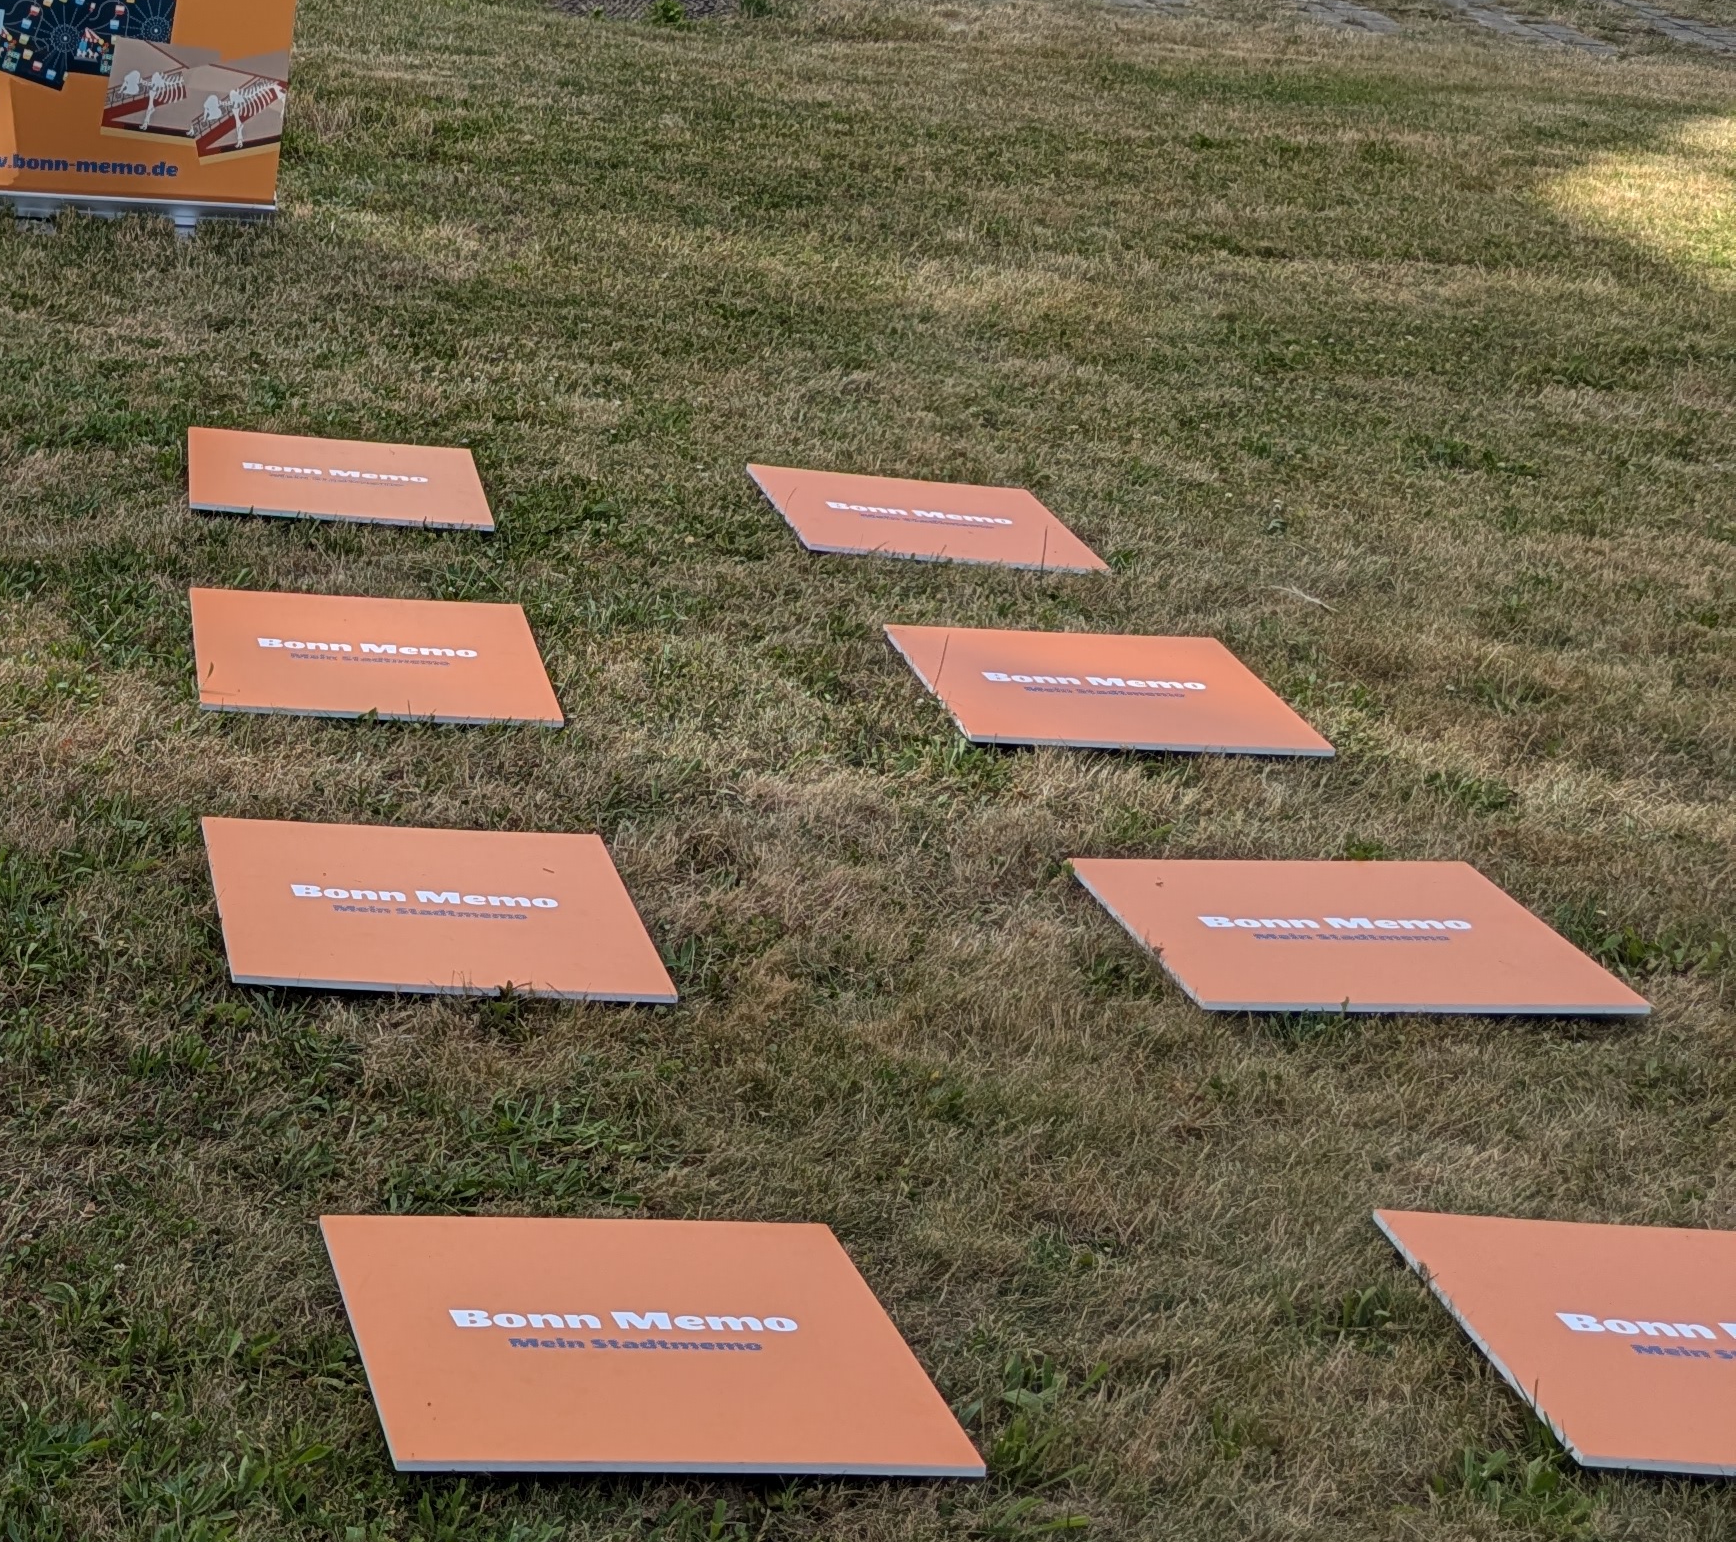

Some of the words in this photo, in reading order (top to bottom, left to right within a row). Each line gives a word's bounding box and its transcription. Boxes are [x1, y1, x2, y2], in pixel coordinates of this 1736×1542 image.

[241, 461, 322, 476] Bonn
[328, 468, 429, 483] Memo
[825, 501, 908, 516] Bonn
[911, 509, 1013, 526] Memo
[257, 636, 353, 652] Bonn
[360, 642, 478, 658] Memo
[981, 671, 1082, 686] Bonn
[1085, 675, 1207, 691] Memo
[289, 884, 408, 902] Bonn
[414, 890, 560, 908] Memo
[1196, 916, 1321, 929] Bonn
[1322, 917, 1473, 931] Memo
[448, 1309, 603, 1329] Bonn
[609, 1311, 799, 1332] Memo
[1555, 1312, 1718, 1340] Bonn
